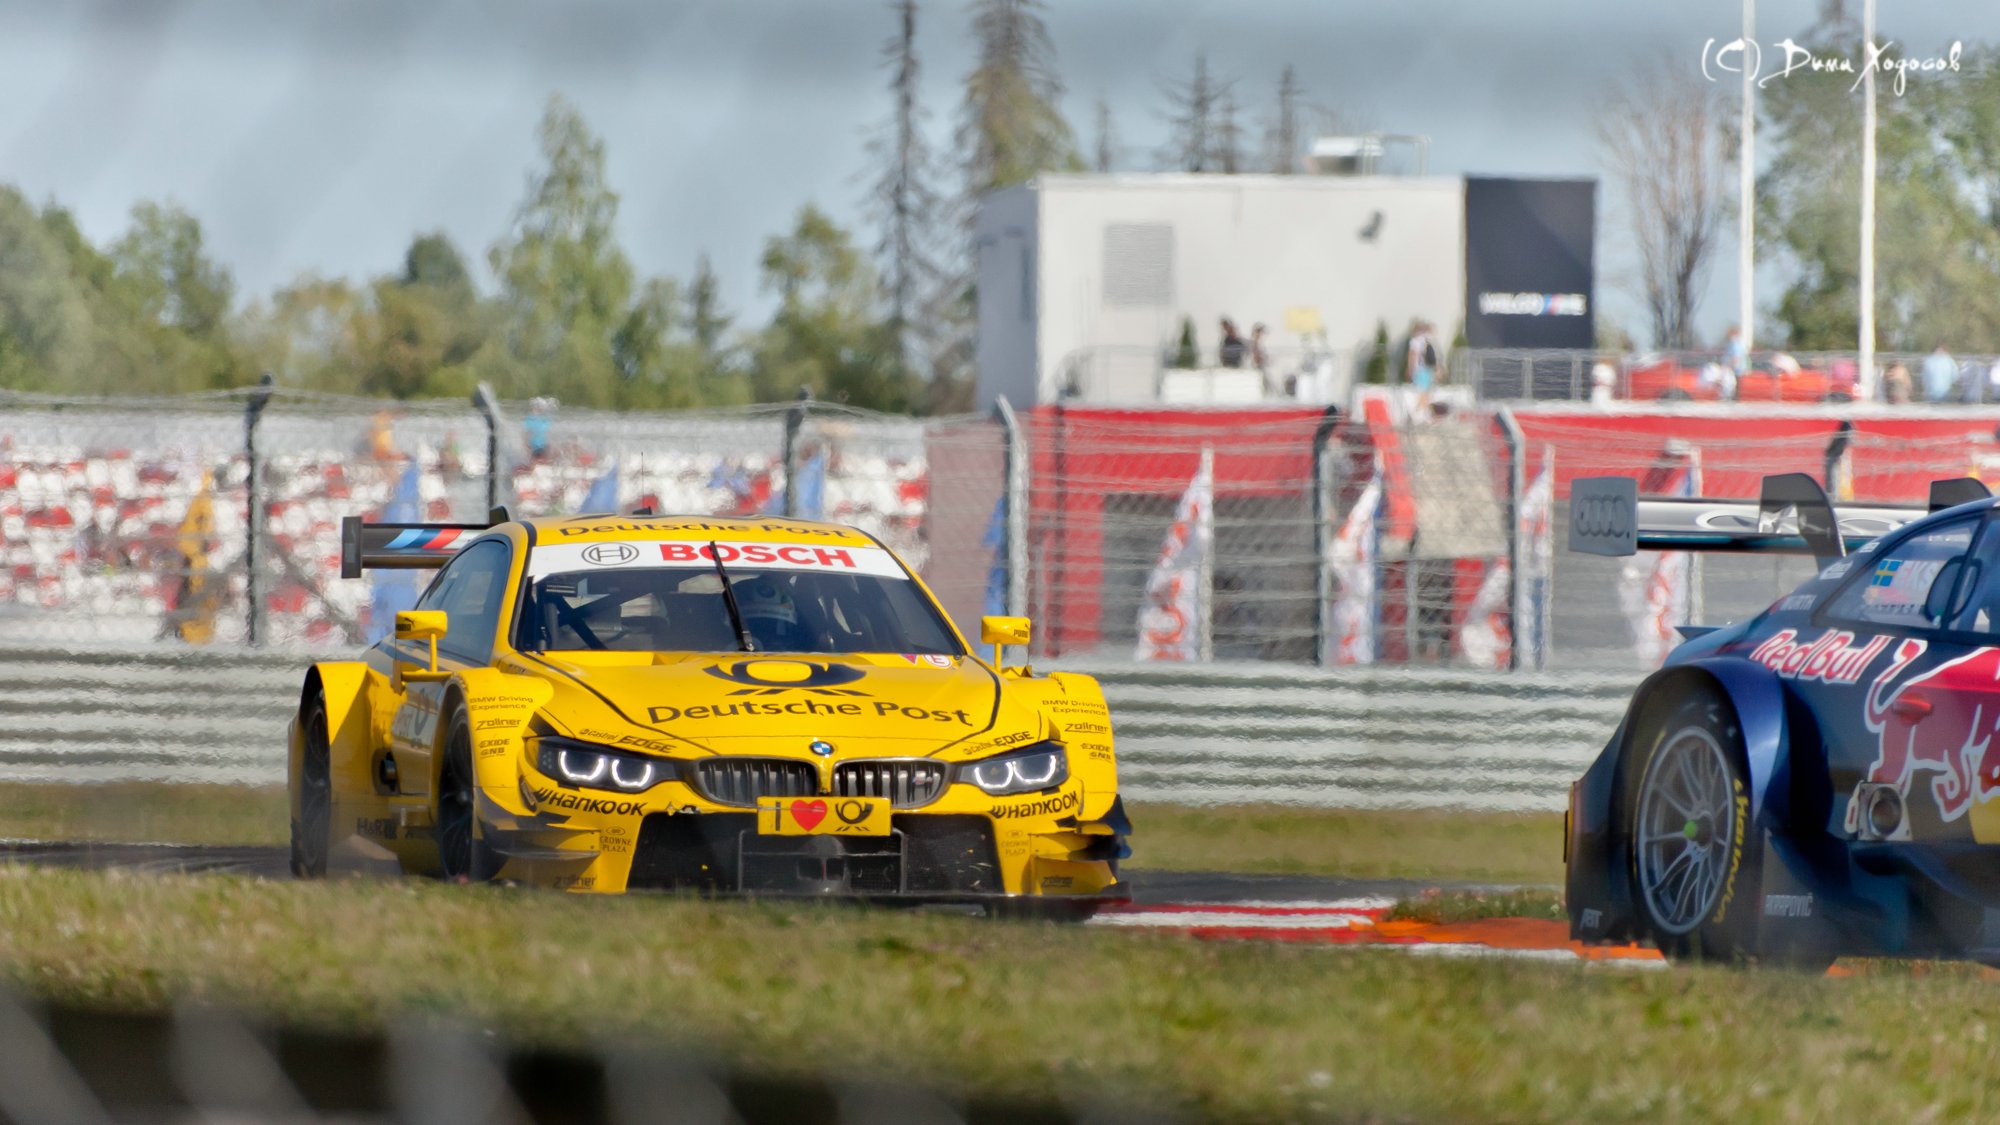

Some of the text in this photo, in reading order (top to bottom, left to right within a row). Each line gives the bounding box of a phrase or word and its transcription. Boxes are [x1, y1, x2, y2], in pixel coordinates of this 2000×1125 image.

[559, 521, 851, 538] Deutsche Post
[659, 543, 857, 568] BOSCH
[498, 695, 534, 703] Driving
[1071, 700, 1106, 710] Driving
[471, 704, 527, 712] Experience
[647, 699, 973, 727] Deutsche Post
[1052, 706, 1107, 716] Experience
[618, 735, 677, 754] EDGE
[993, 731, 1035, 747] EDGE
[775, 801, 781, 832] I
